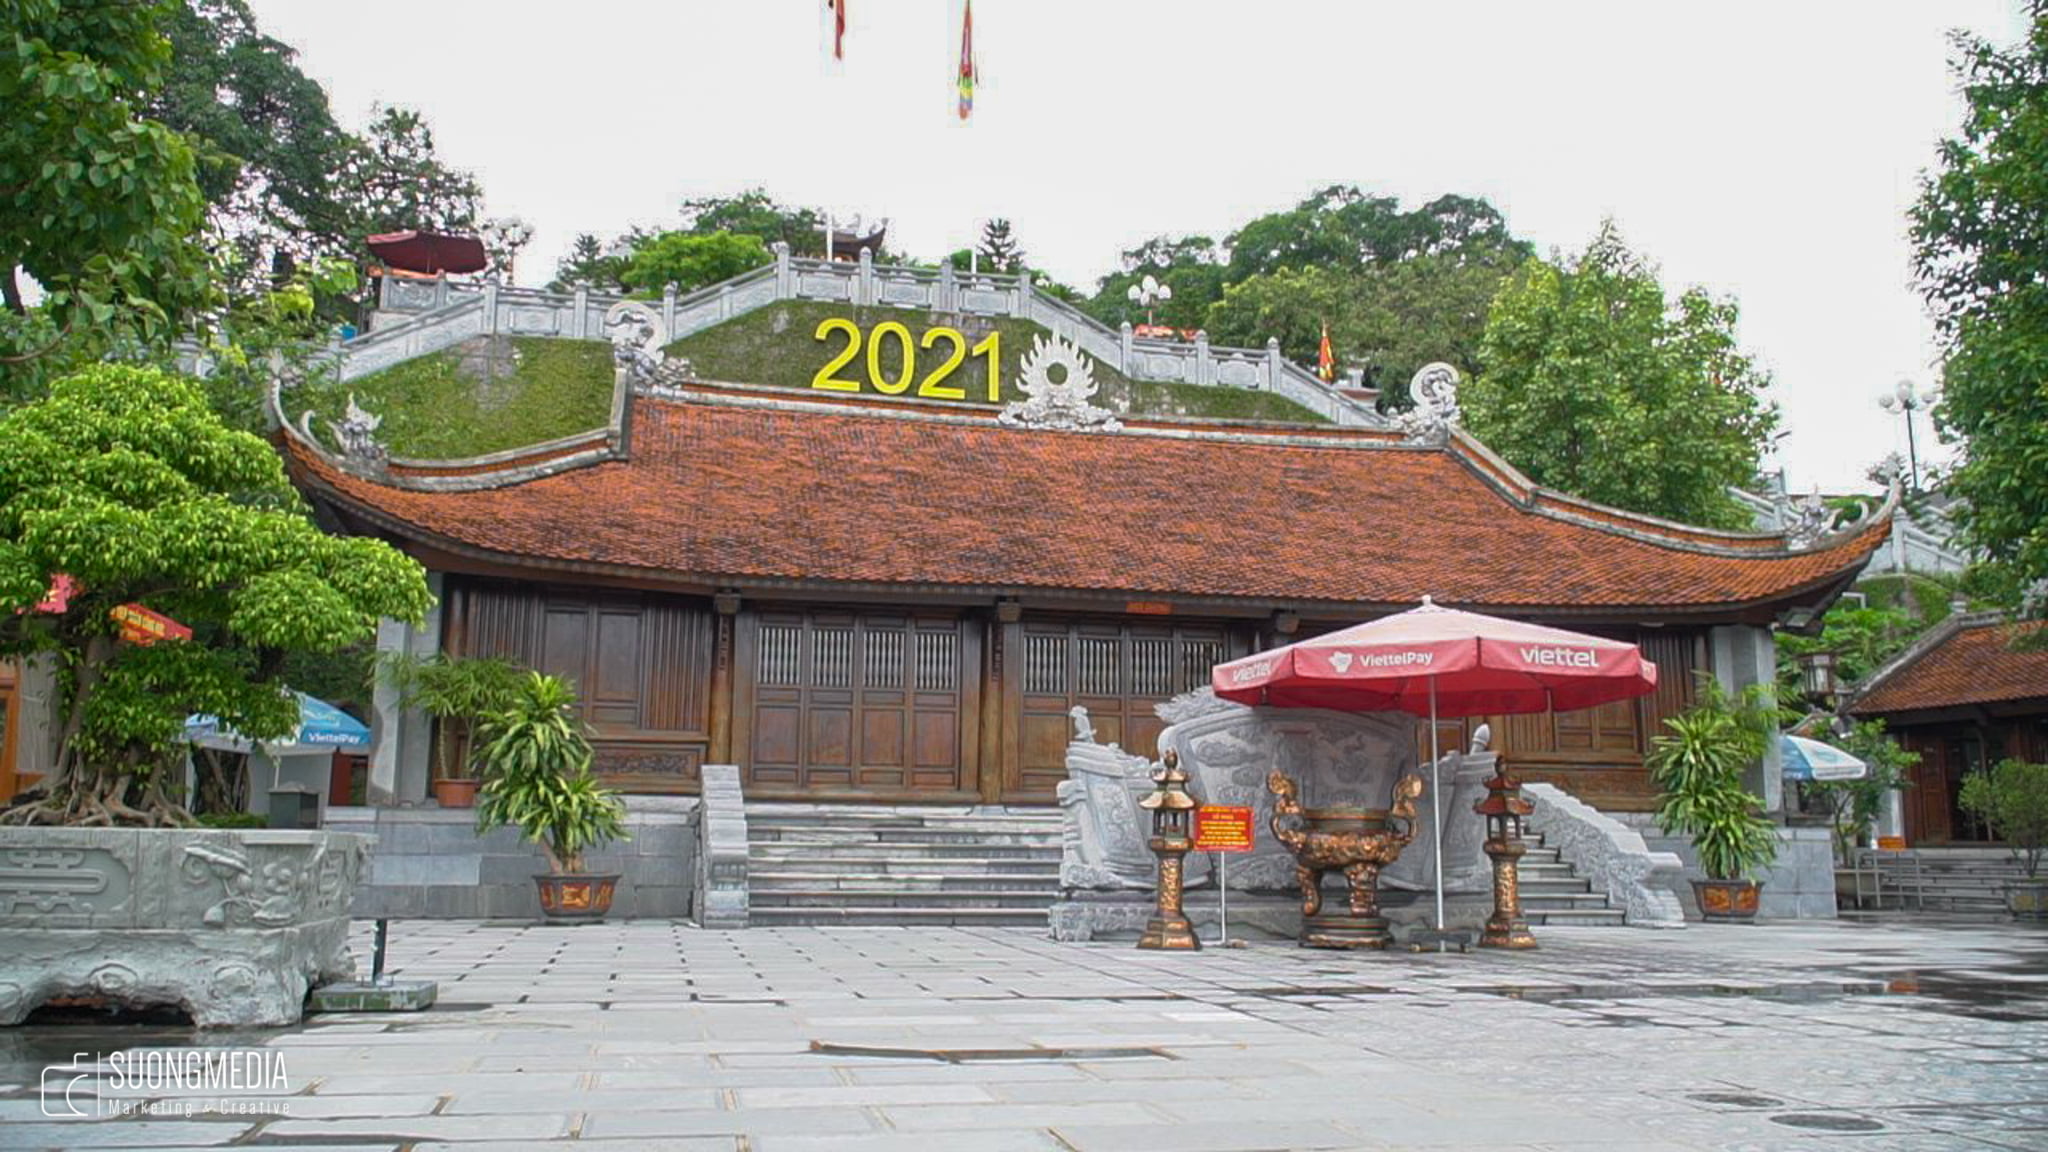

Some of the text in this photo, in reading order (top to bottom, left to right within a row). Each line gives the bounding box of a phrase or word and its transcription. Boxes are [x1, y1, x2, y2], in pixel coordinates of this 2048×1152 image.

[811, 317, 1001, 402] 2021
[1360, 651, 1433, 668] ViettelPay
[1520, 646, 1599, 667] viettel
[308, 732, 361, 744] ViettelPay
